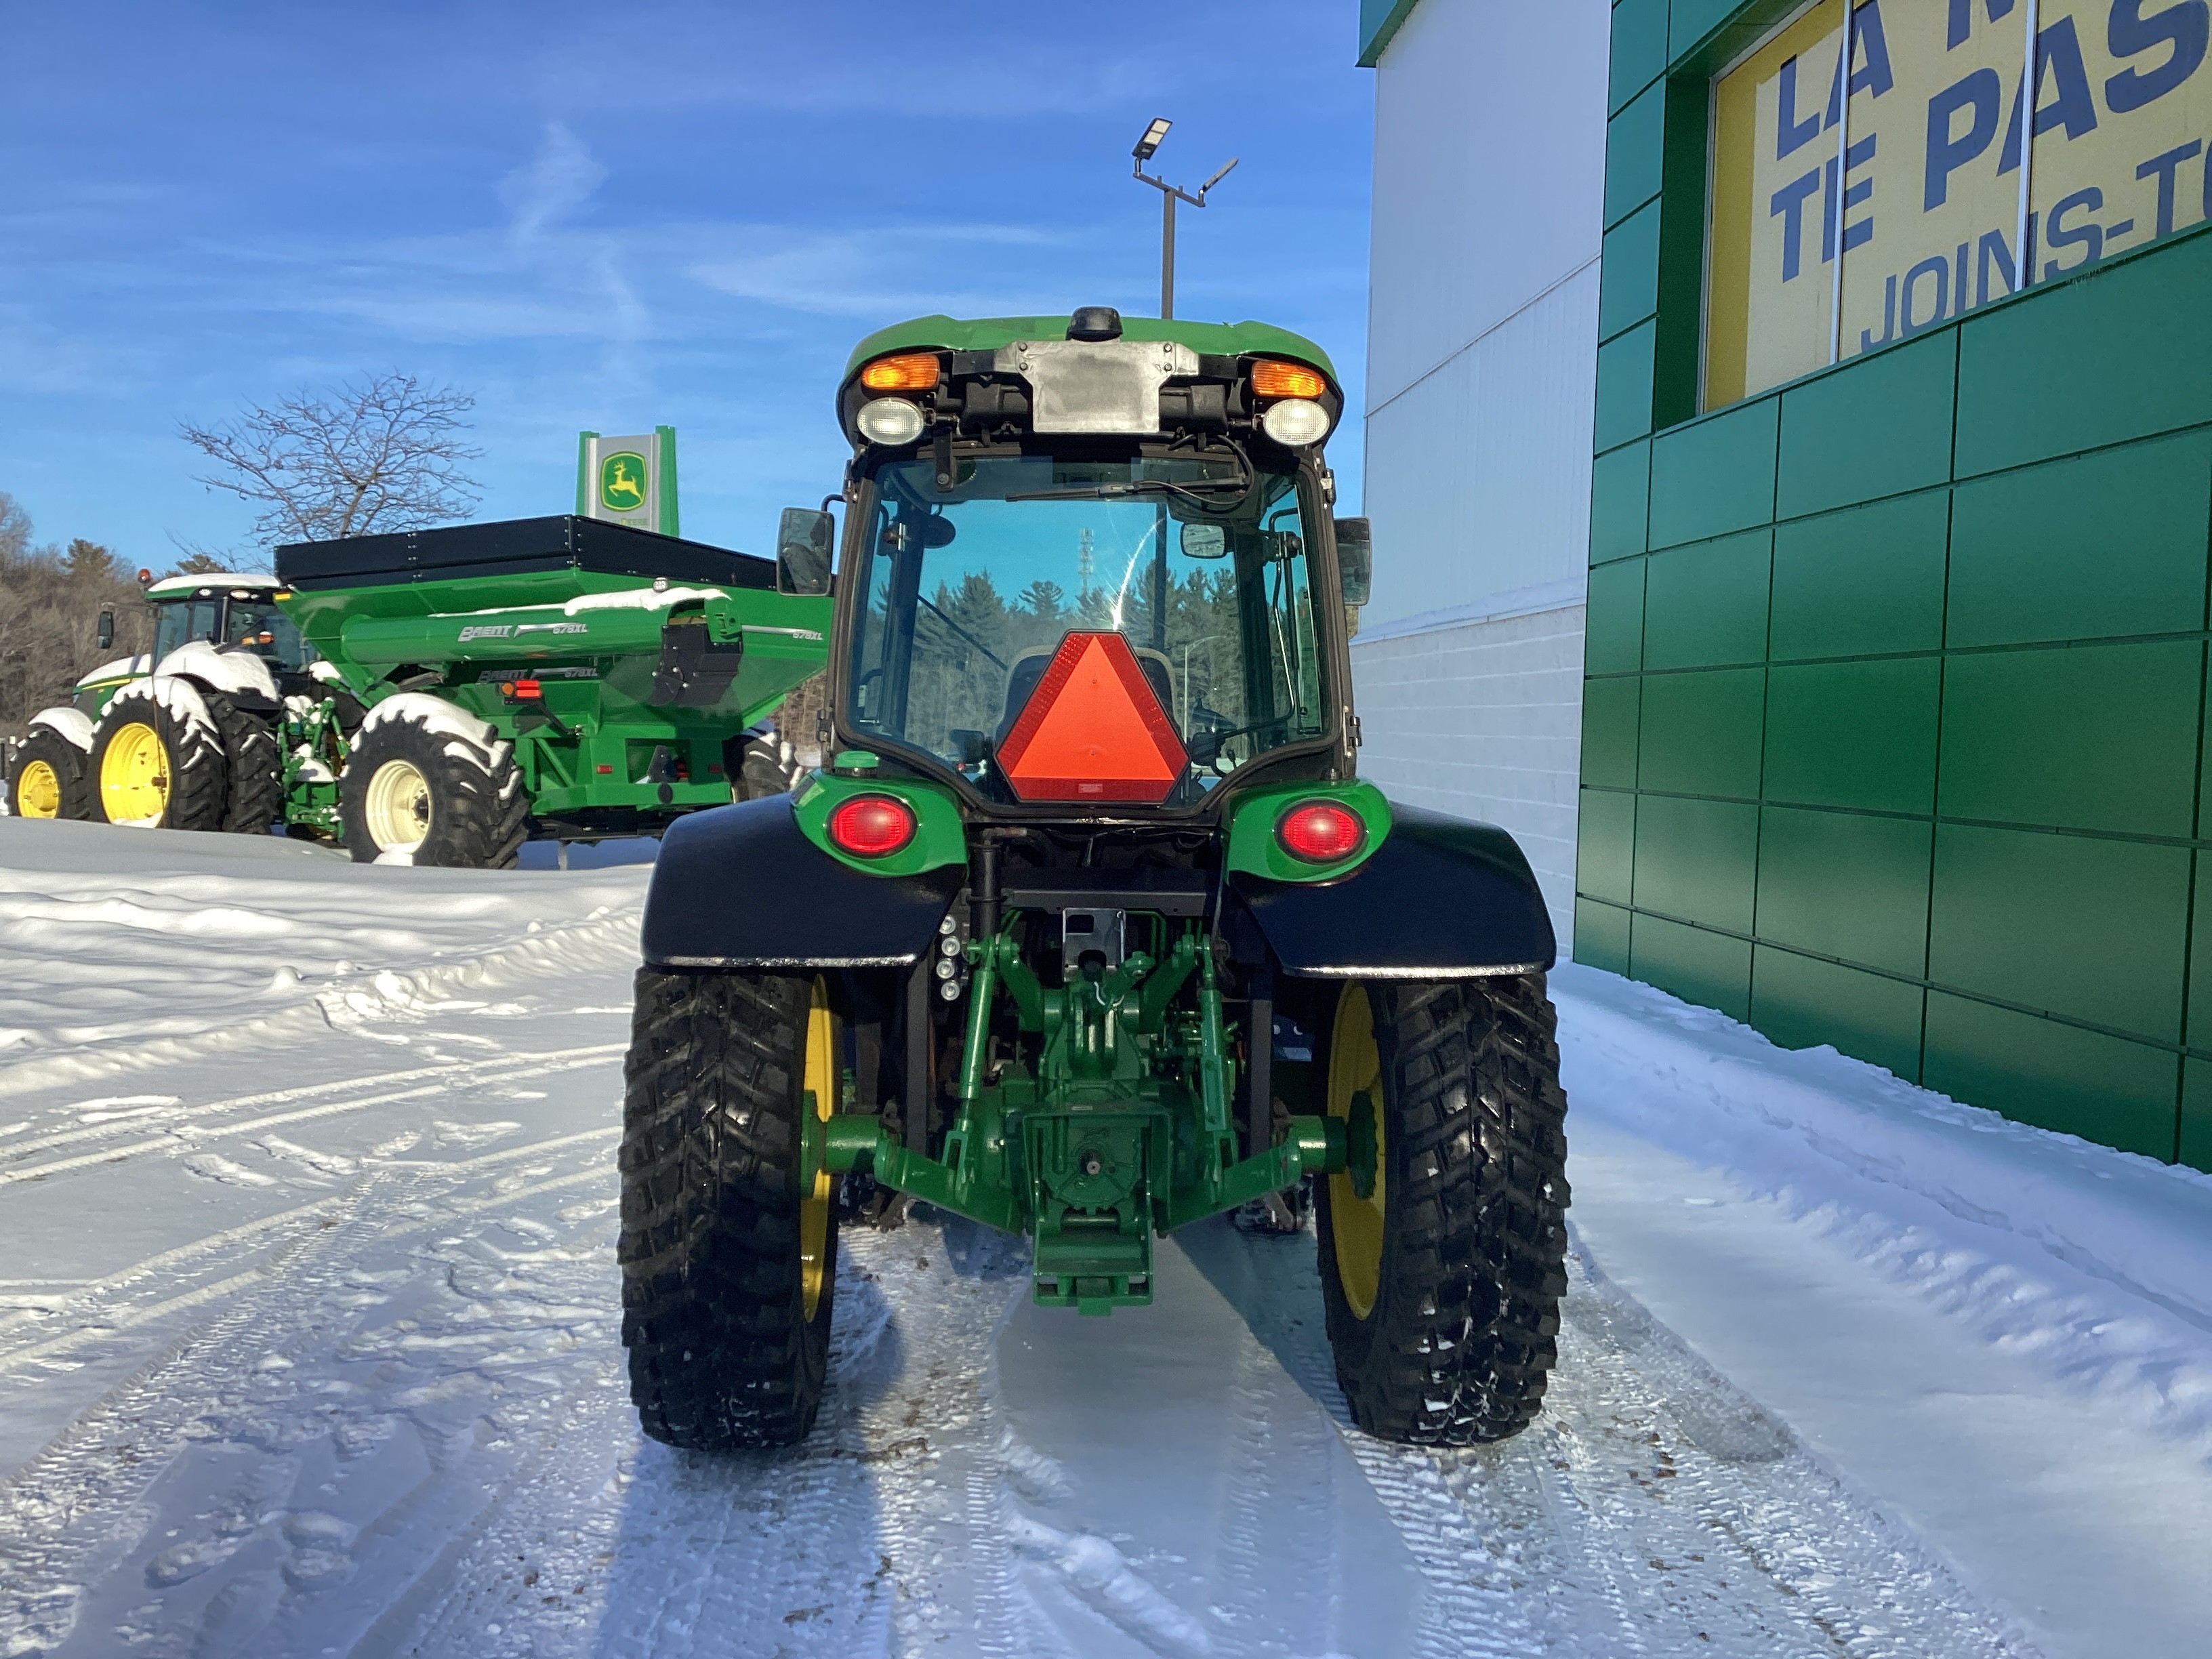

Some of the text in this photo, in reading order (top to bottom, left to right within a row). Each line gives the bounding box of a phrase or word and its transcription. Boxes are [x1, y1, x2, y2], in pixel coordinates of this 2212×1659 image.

[1777, 0, 1894, 161] LA
[1770, 133, 1877, 283] TE
[1861, 138, 2212, 353] JOINS-T
[458, 623, 587, 642] BRENT 678XL
